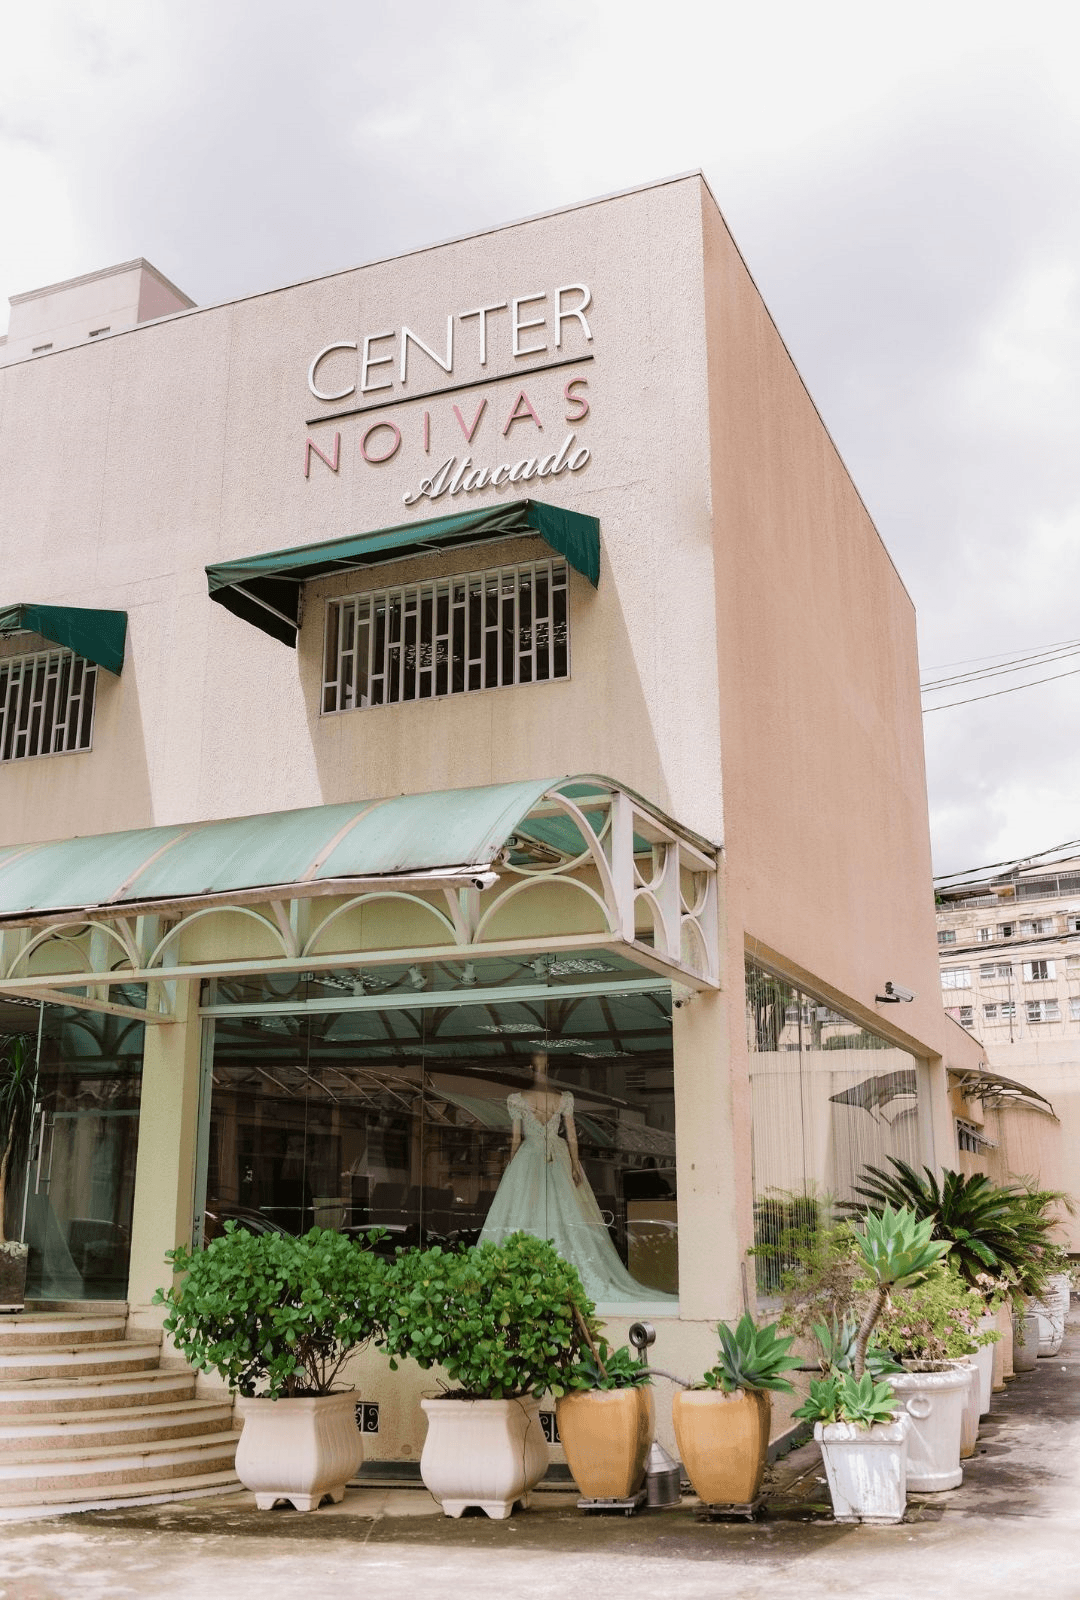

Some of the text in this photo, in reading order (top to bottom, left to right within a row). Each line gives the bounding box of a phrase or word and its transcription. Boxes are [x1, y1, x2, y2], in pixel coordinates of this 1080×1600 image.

[307, 282, 593, 401] CENTER
[304, 376, 590, 478] NOIVAS
[402, 432, 591, 505] Atacado
